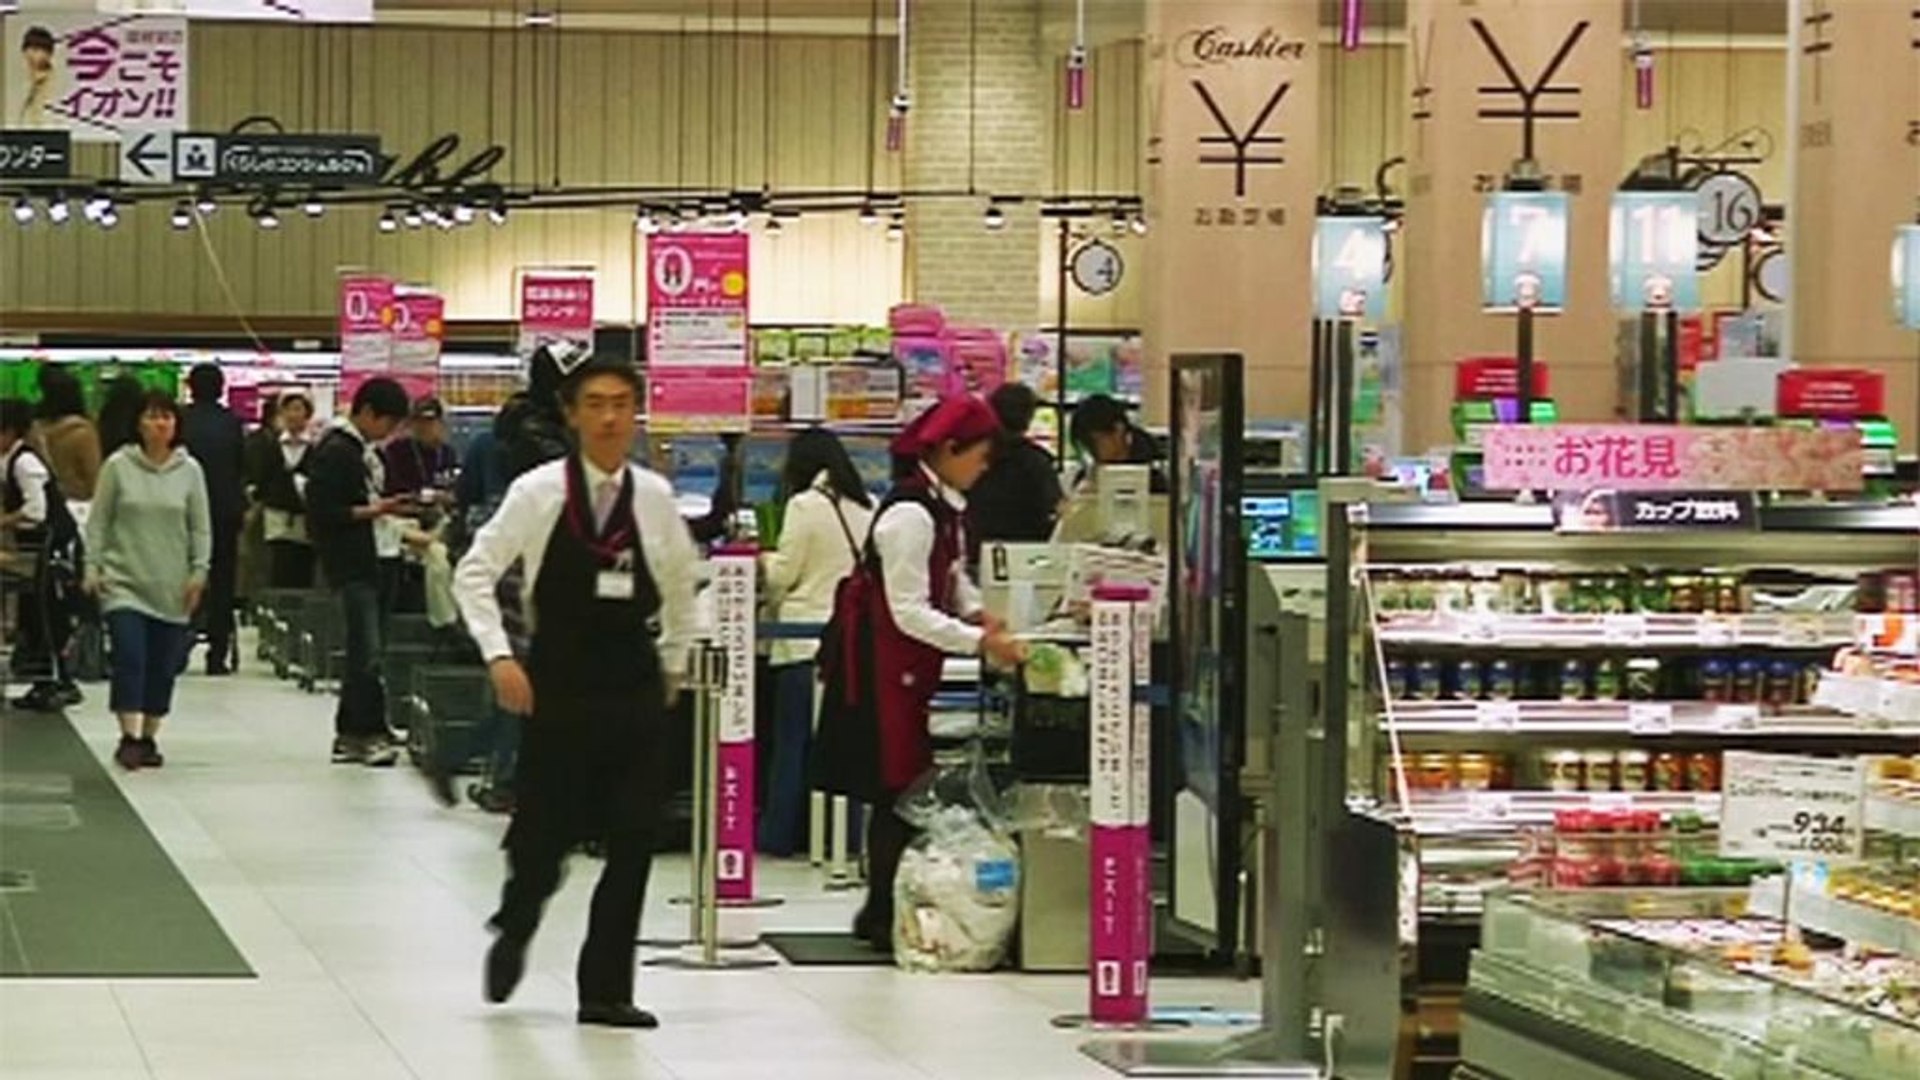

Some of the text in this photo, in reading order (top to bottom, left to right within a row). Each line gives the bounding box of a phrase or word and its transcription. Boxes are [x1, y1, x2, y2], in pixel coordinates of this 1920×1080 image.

[66, 29, 181, 82] 今こそ
[1175, 27, 1304, 68] Cashier
[1713, 190, 1752, 232] 16
[1555, 437, 1681, 478] お花見
